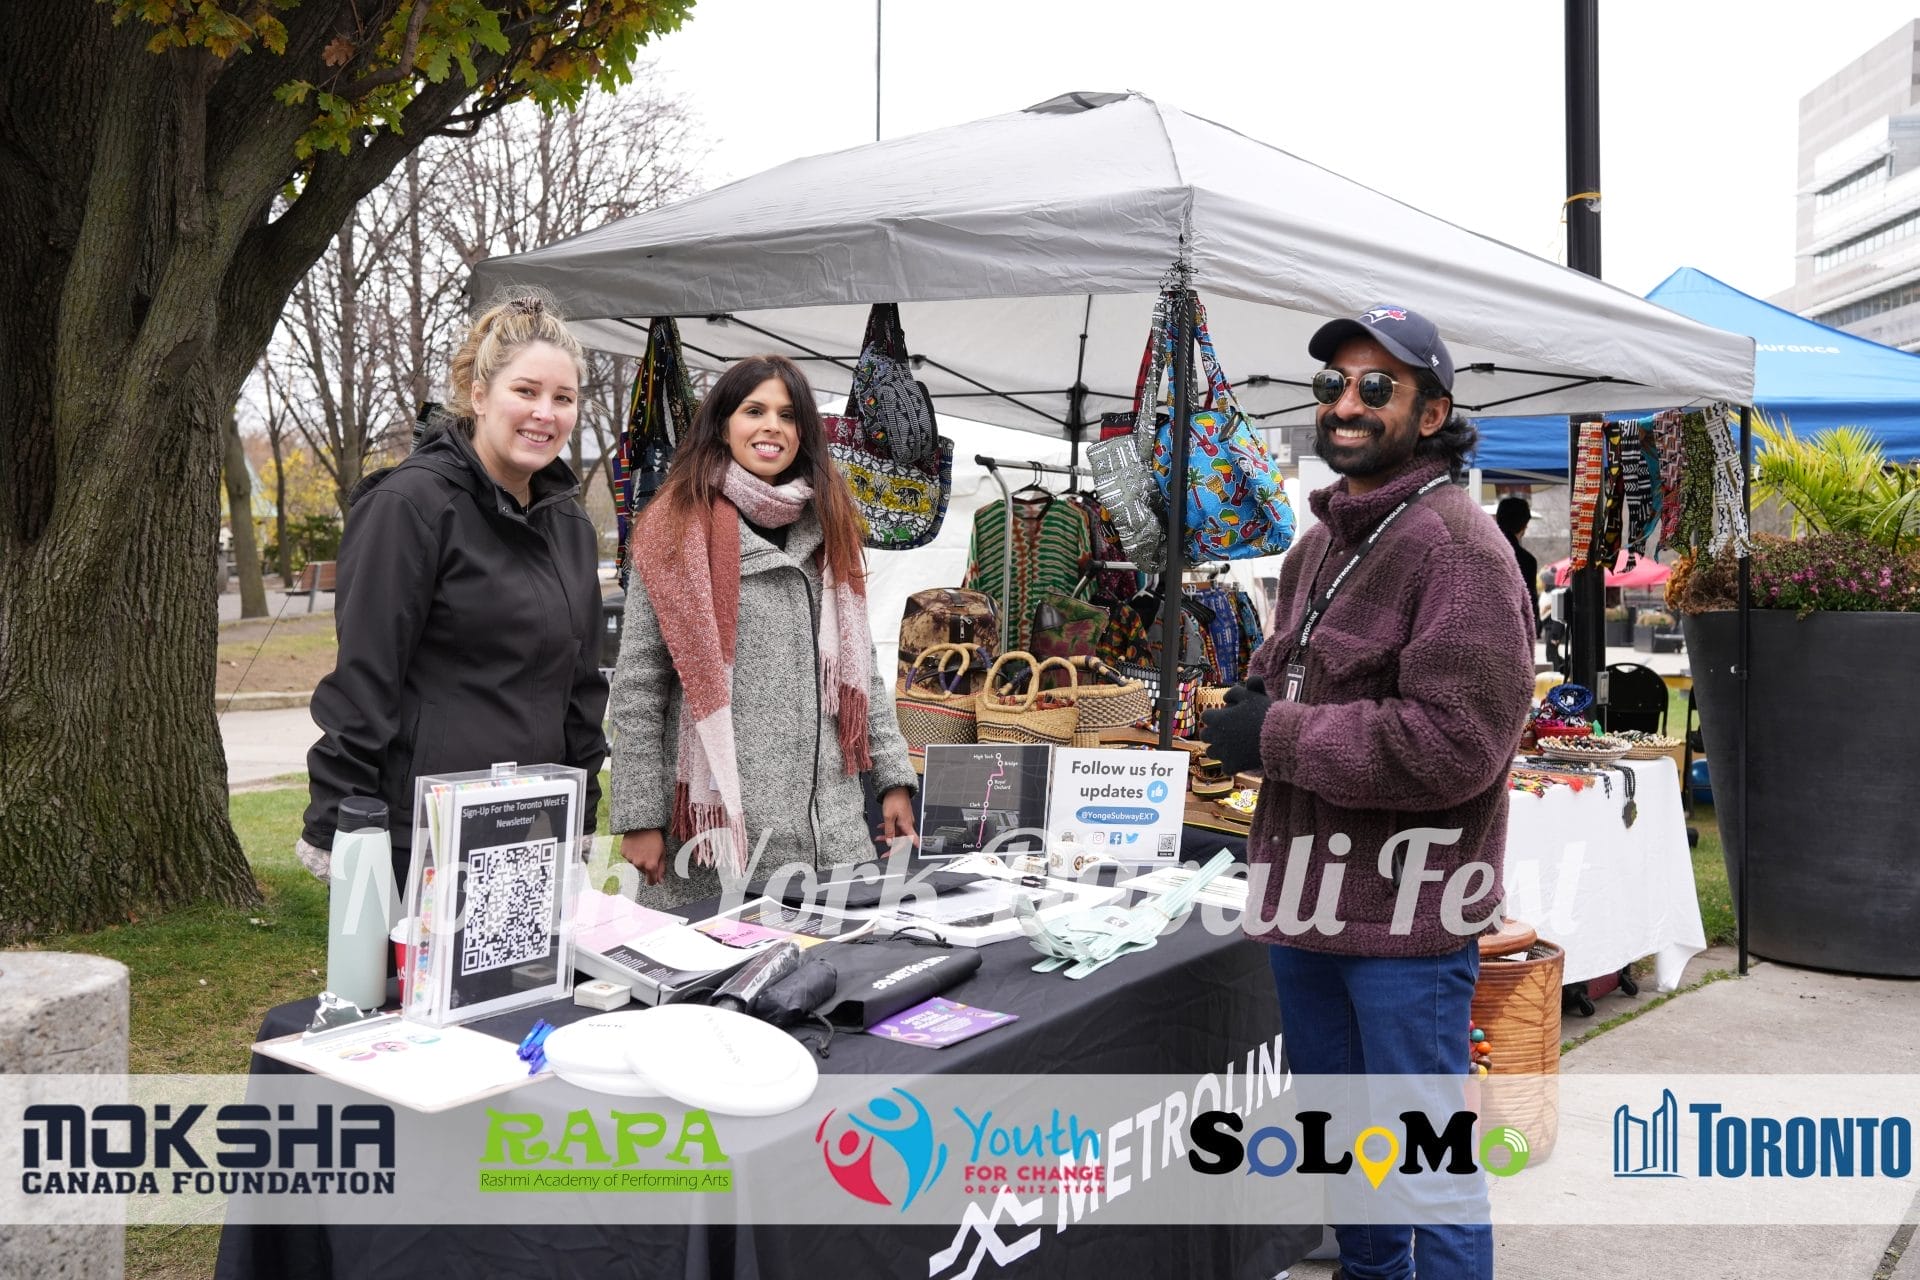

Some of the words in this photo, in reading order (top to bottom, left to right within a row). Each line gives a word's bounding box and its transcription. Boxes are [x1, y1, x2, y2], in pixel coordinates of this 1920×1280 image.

[1376, 502, 1408, 534] METROLINX
[1332, 555, 1360, 588] METROLINX
[1072, 760, 1125, 776] Follow
[1129, 765, 1147, 776] us
[1150, 762, 1174, 777] for
[1080, 783, 1144, 801] updates
[462, 804, 489, 818] Sign-Up
[491, 804, 503, 815] For
[503, 802, 515, 812] the
[516, 800, 543, 812] Toronto
[543, 797, 560, 807] West
[1081, 810, 1154, 822] @YongeSubwayEXT
[496, 815, 536, 828] Newsletter!
[1056, 1033, 1293, 1234] METROLIN
